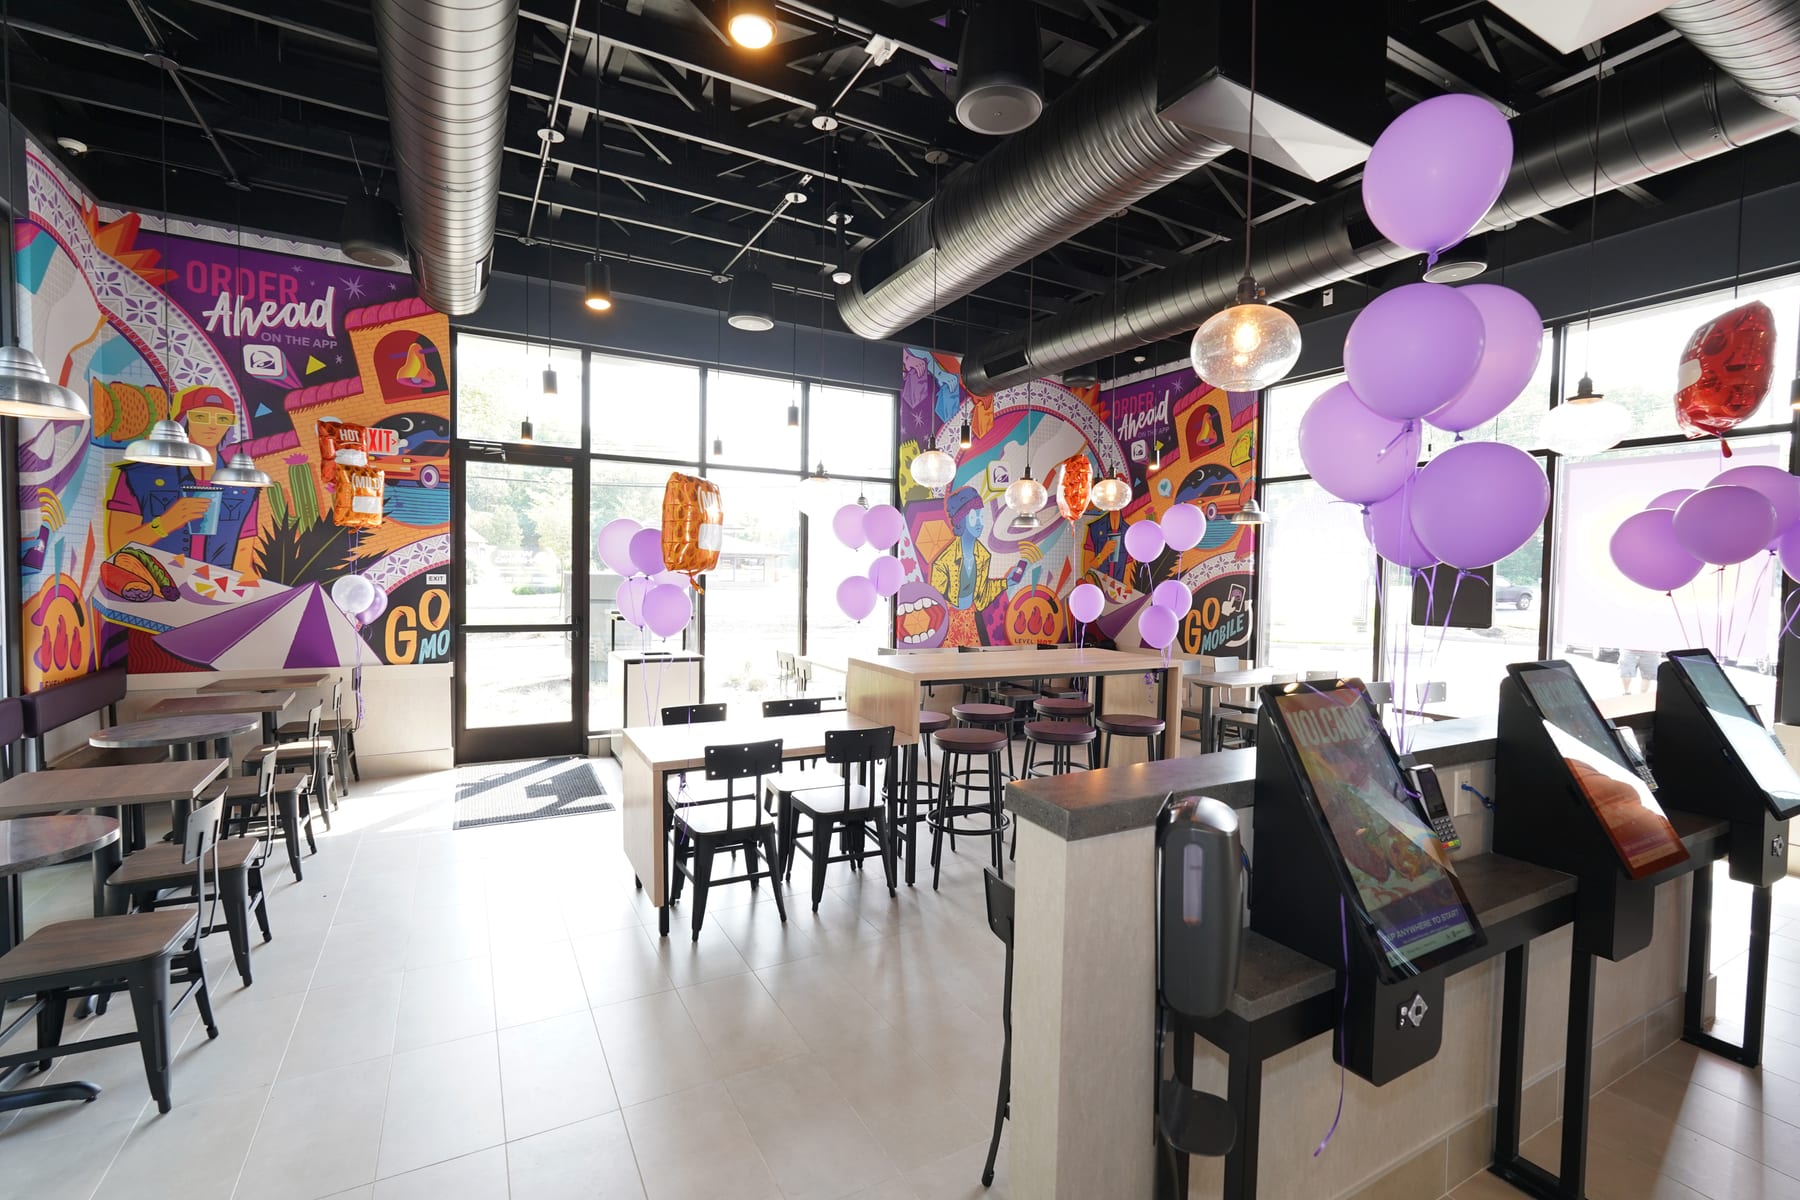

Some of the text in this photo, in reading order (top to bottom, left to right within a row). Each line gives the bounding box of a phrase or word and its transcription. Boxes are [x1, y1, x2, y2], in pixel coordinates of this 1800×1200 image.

[186, 260, 298, 305] ORDER
[202, 286, 336, 337] Ahead
[261, 332, 338, 349] ON THE APP
[339, 429, 360, 442] HOT
[1118, 389, 1170, 440] Ahead
[368, 429, 393, 453] XIT
[385, 589, 450, 665] GO
[1184, 597, 1221, 655] GO
[1201, 613, 1245, 655] MOBILE
[1397, 920, 1432, 939] ANYWHERE
[1432, 916, 1442, 924] TO
[1441, 909, 1459, 921] START
